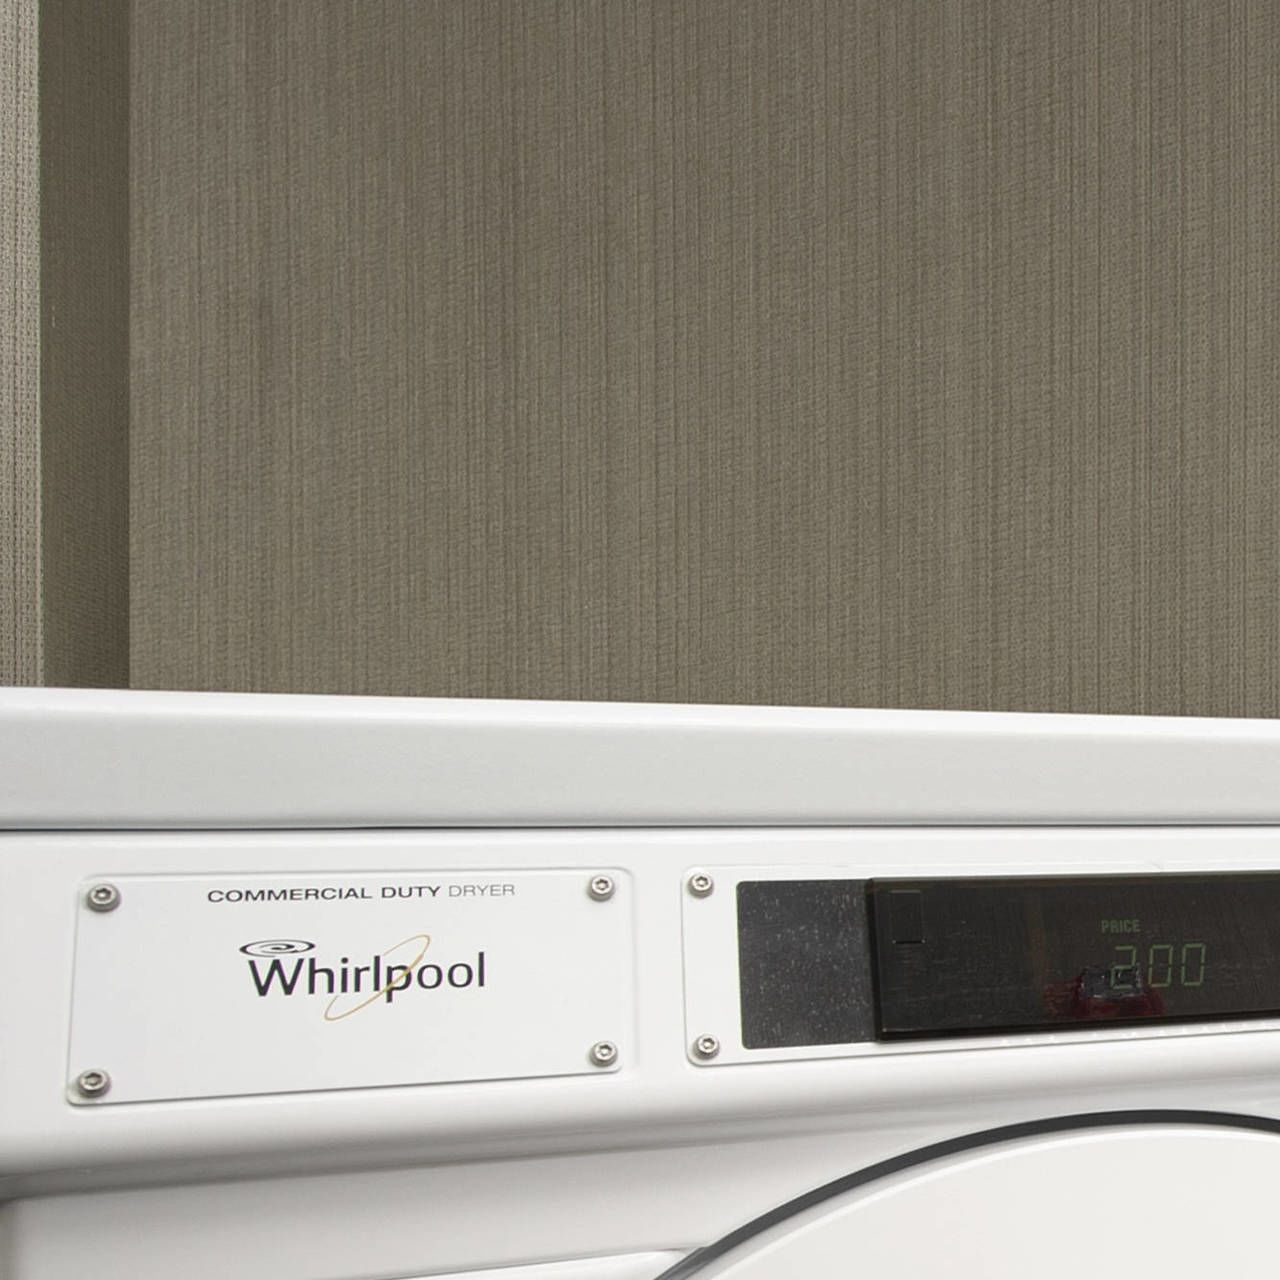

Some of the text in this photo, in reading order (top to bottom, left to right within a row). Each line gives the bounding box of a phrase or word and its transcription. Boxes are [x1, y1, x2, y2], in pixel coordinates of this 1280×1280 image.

[207, 884, 516, 902] COMMERCIAL DUTY DRYER
[1101, 919, 1141, 933] PRICE
[247, 952, 487, 1004] Whirlpool
